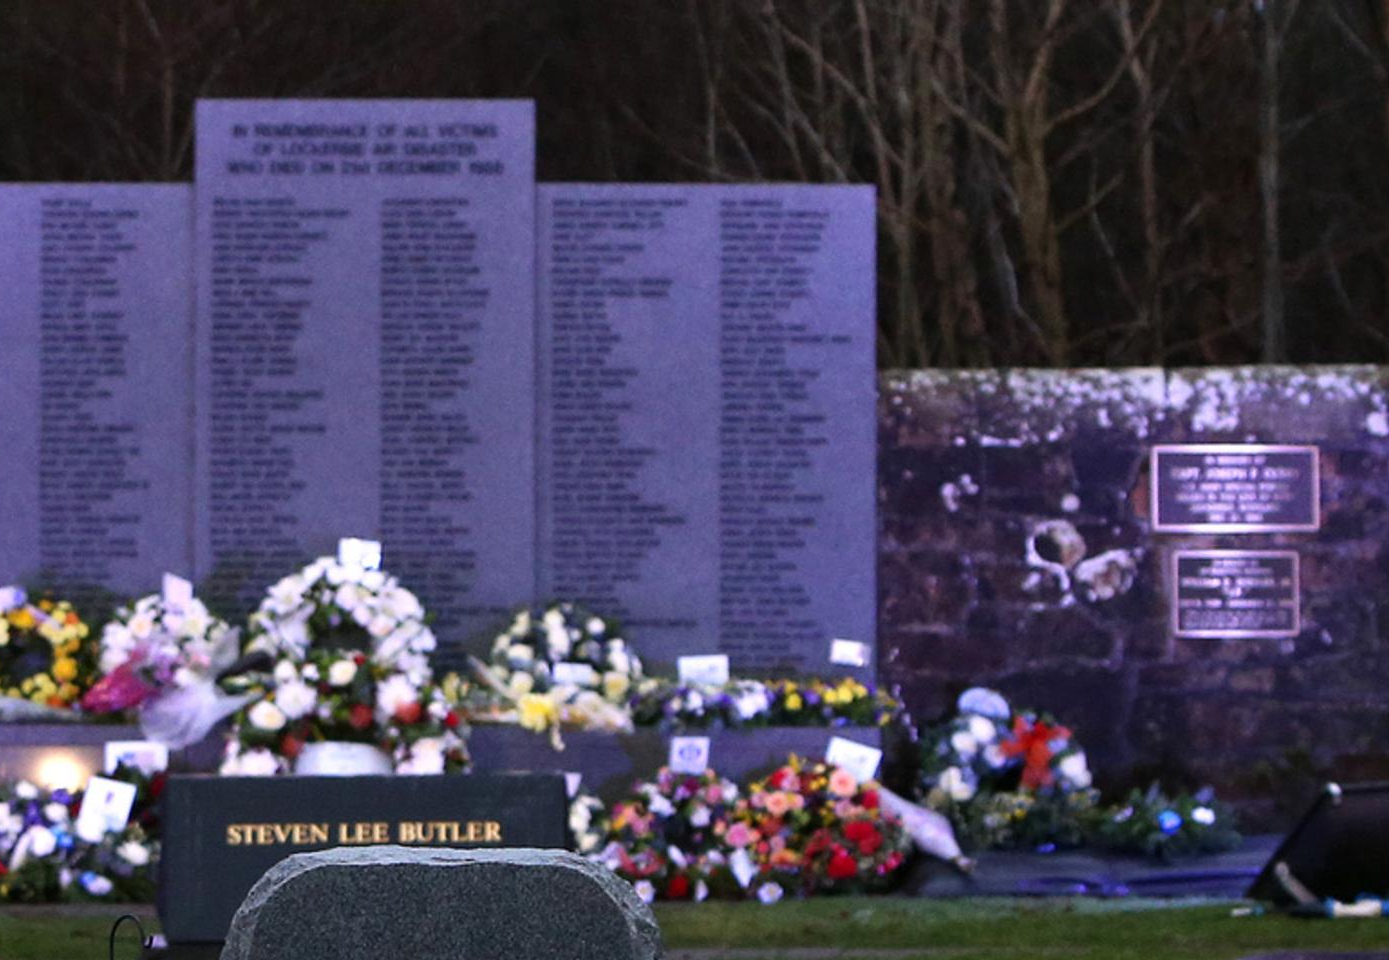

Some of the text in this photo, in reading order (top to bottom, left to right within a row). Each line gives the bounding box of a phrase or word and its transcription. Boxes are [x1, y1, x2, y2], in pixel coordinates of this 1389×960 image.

[231, 125, 499, 137] IN REMEMBRANCE OF ALL VICTIMS
[253, 142, 478, 155] OF LOCKERBIE AIR DISASTER
[378, 161, 461, 174] DECEMBER
[226, 821, 502, 845] STEVEN LEE BUTLER
